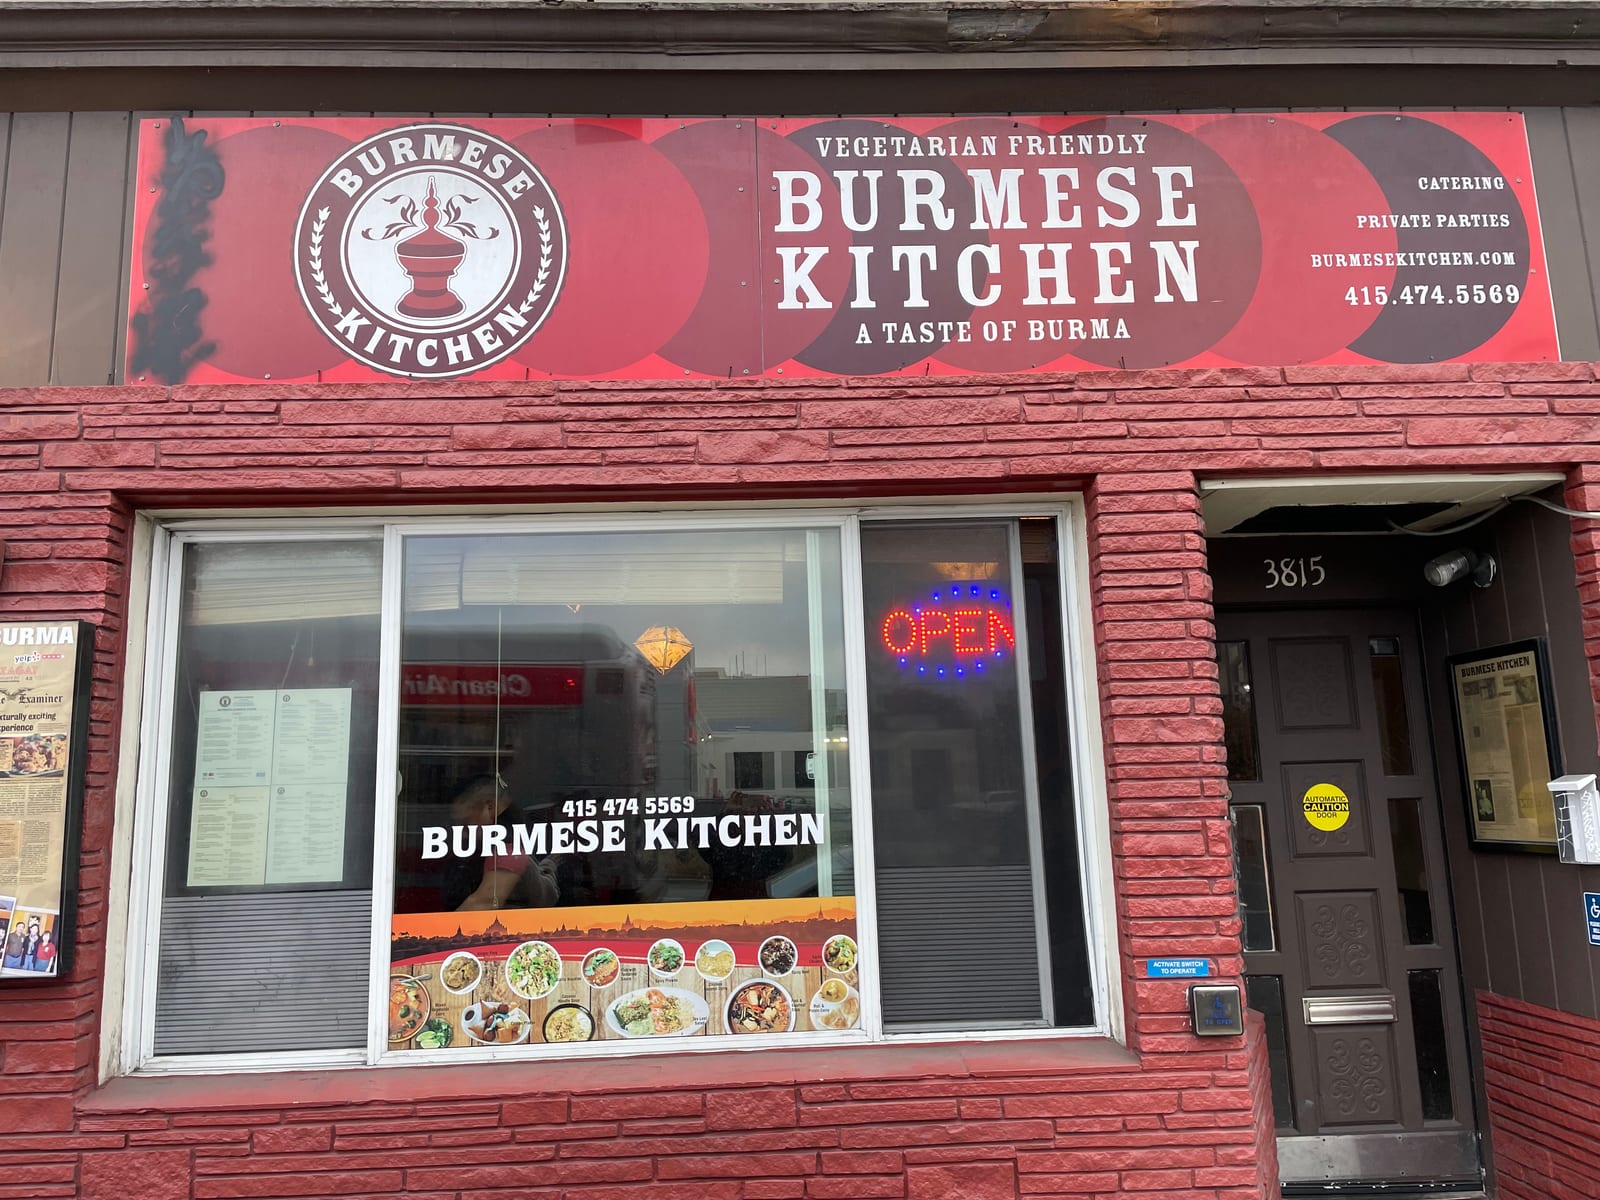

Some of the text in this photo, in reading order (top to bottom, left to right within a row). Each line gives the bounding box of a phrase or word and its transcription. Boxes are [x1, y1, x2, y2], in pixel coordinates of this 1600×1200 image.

[816, 134, 1147, 158] VEGETARIAN FRIENDLY
[330, 134, 535, 200] BURMESE
[1418, 176, 1505, 190] CATERING
[773, 166, 1198, 233] BURMESE
[1356, 214, 1510, 229] PRIVATE PARTIES
[1311, 252, 1516, 267] BURMESEKITCHEN.COM
[775, 240, 1200, 310] KITCHEN
[1344, 284, 1520, 306] 415.474.5569
[334, 303, 529, 367] KITCHEN
[855, 318, 1131, 344] A TASTE OF BURMA
[1264, 556, 1325, 588] 3815
[0, 626, 74, 646] URMA
[883, 609, 1015, 655] OPEN
[15, 655, 32, 664] yelp
[1461, 656, 1530, 678] BURMESE KITCHEN
[19, 693, 63, 704] Examiner
[28, 713, 57, 721] exciting
[562, 796, 695, 818] 415 474 5569
[1303, 803, 1349, 811] CAUTION
[421, 813, 825, 860] BURMESE KITCHEN
